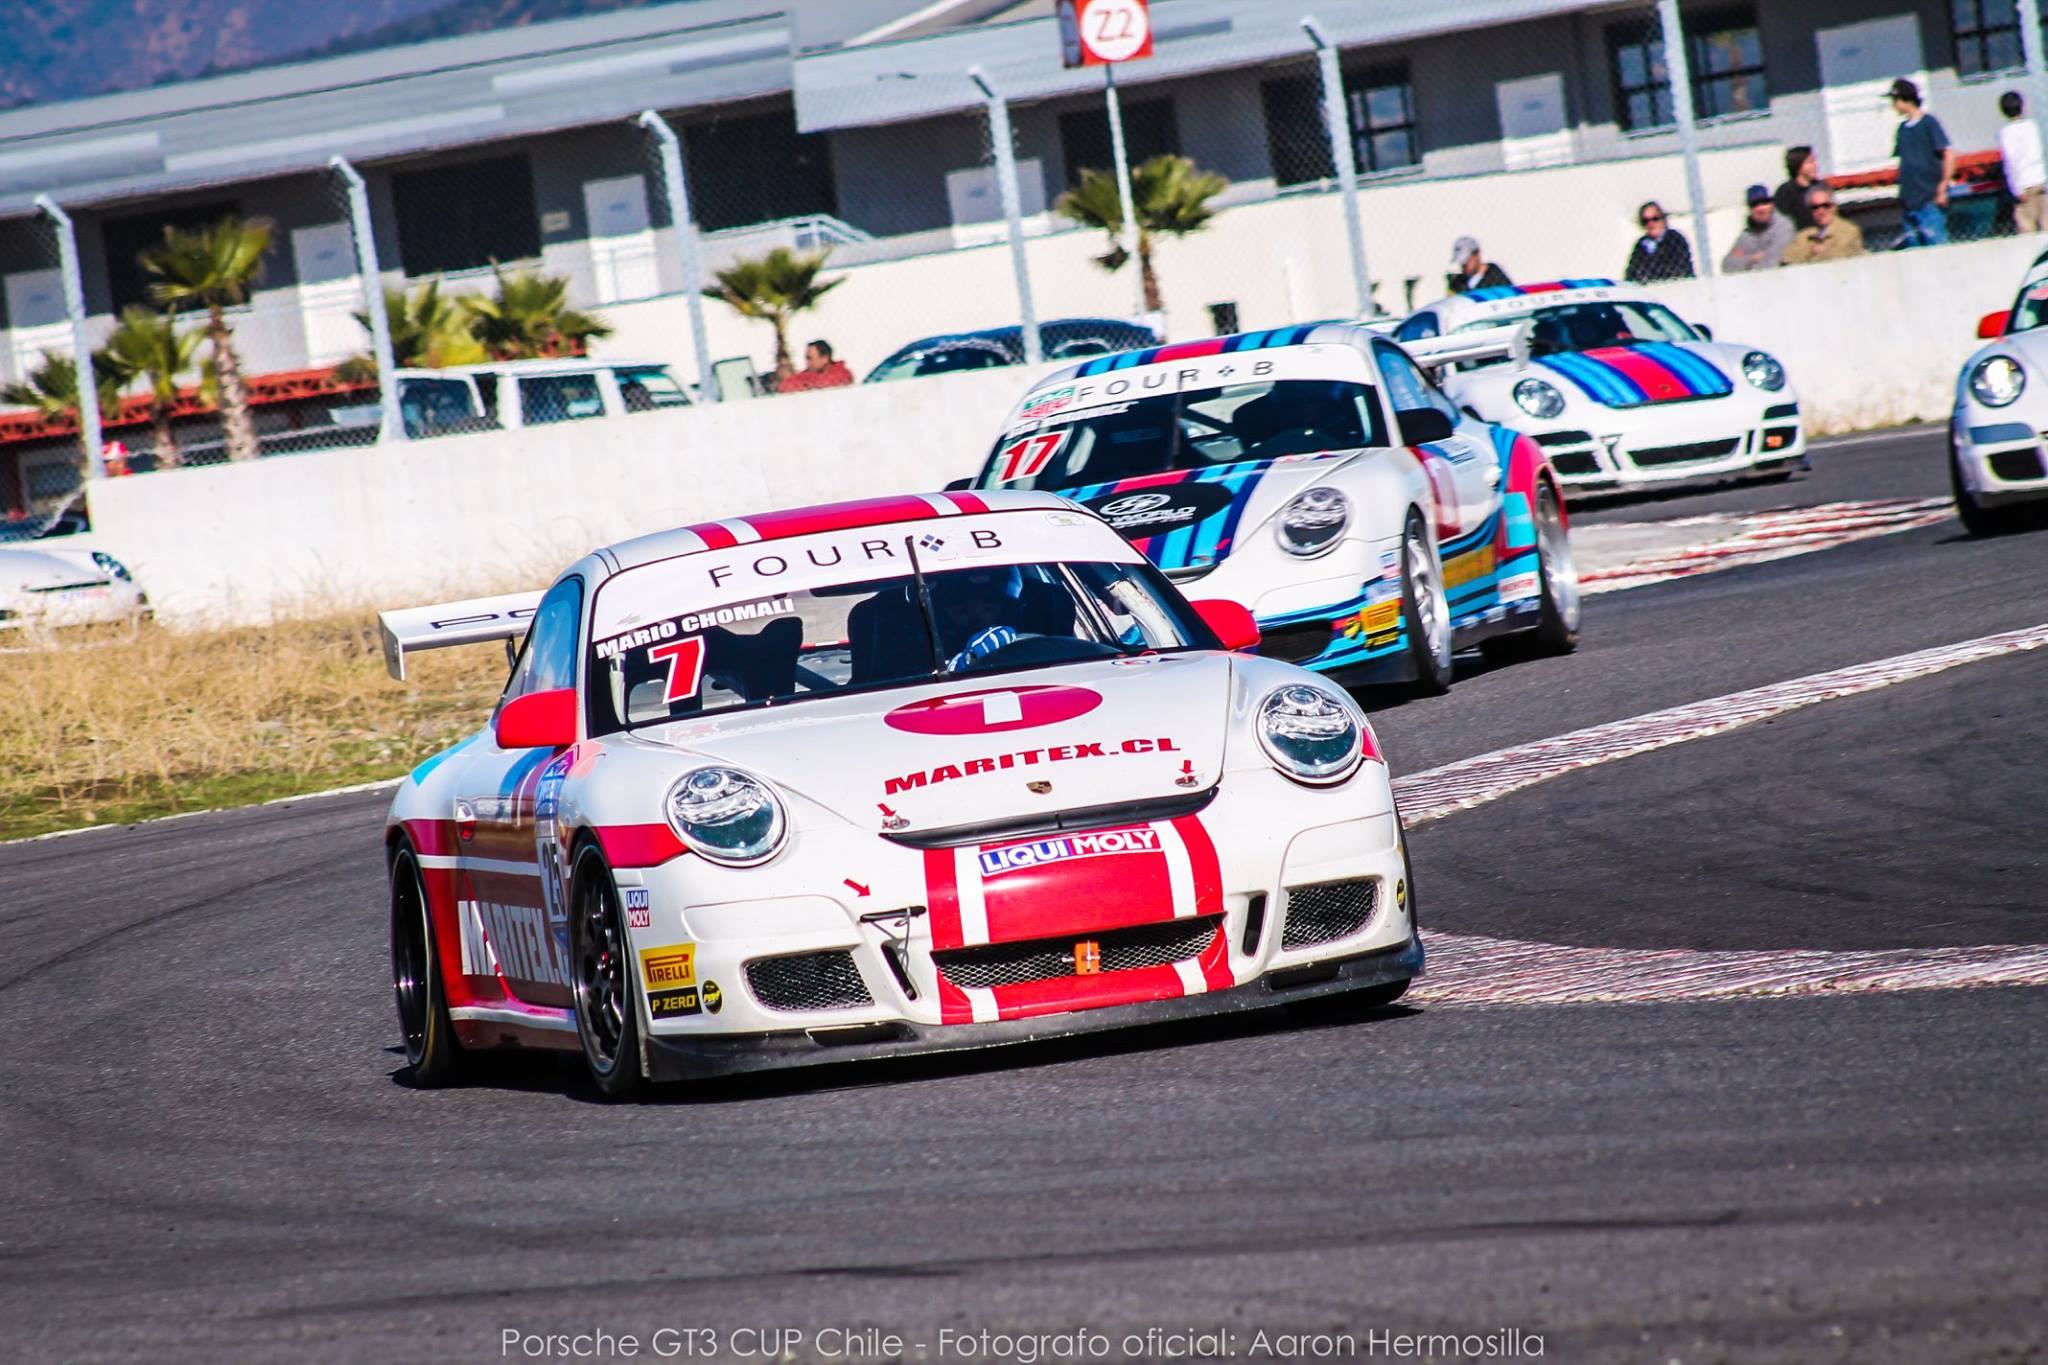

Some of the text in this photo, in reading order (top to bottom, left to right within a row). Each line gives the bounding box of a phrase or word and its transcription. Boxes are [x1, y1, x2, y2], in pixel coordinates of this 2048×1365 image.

[1078, 361, 1275, 401] FOUR B
[998, 431, 1067, 483] 17
[707, 529, 1004, 588] FOUR B
[595, 598, 795, 660] MARIO CHOMALI
[647, 635, 705, 704] 7
[884, 738, 1181, 796] MARITEX.CL
[982, 831, 1156, 872] LIQUI MOLY
[627, 890, 648, 909] LIQUI
[629, 909, 650, 928] MOLY
[645, 953, 690, 984] PIRELLI
[652, 994, 697, 1012] P ZERO
